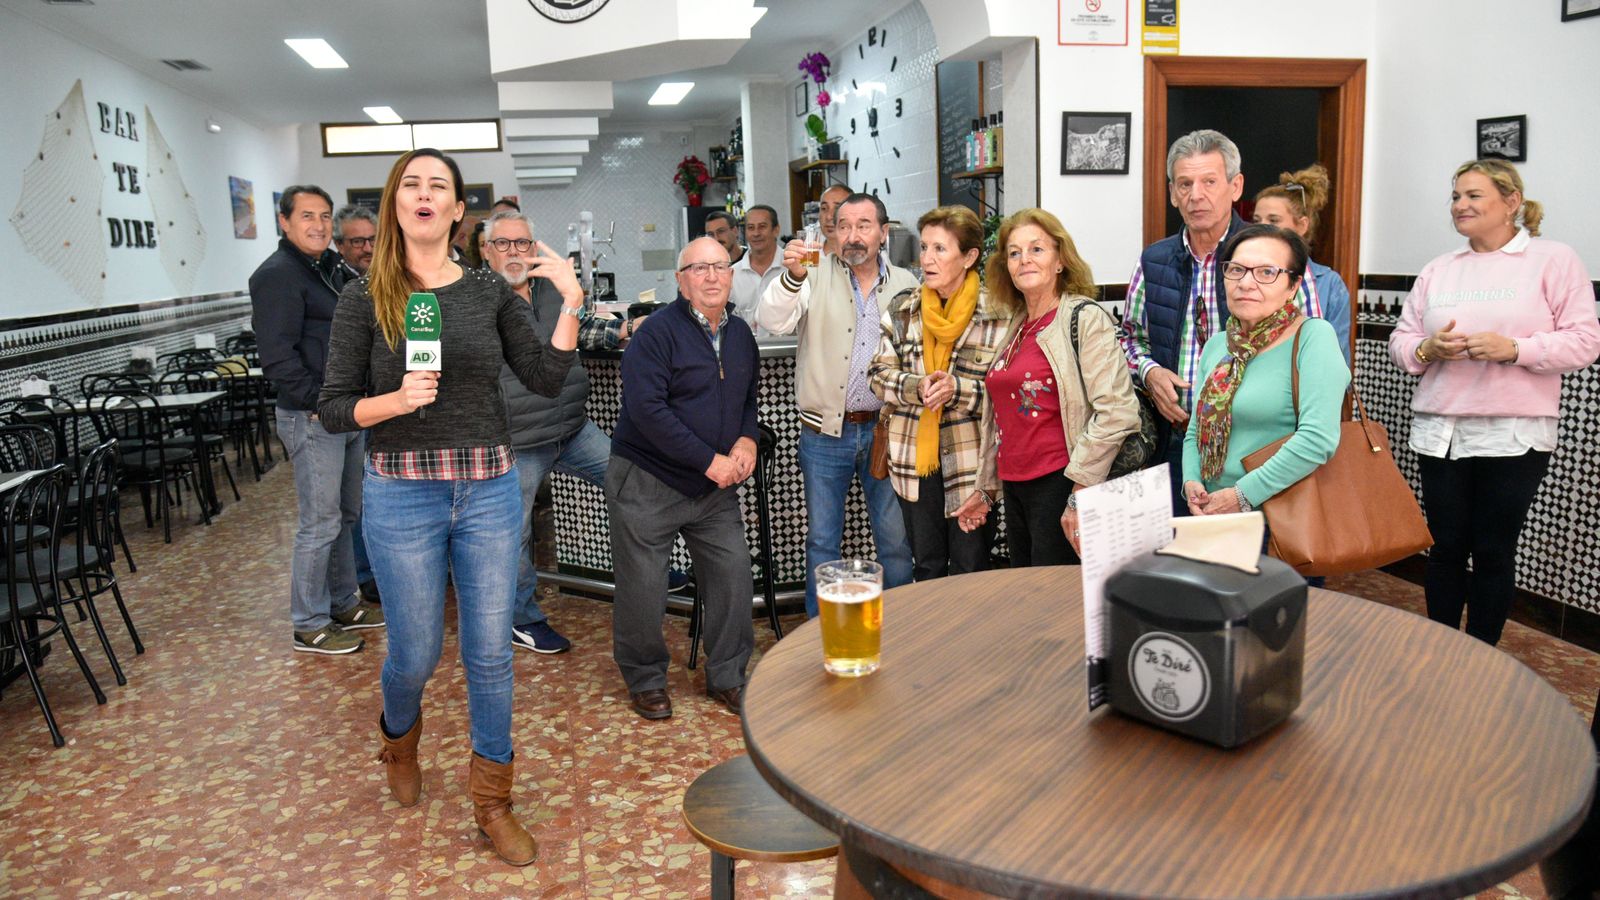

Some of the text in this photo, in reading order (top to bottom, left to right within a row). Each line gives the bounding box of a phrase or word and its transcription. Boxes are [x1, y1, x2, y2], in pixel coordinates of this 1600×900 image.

[895, 97, 903, 118] 3
[97, 101, 139, 142] BAR
[851, 118, 856, 134] 9
[112, 161, 141, 195] TE
[107, 217, 157, 249] DIRE
[412, 352, 430, 362] AD
[1143, 647, 1159, 664] Te
